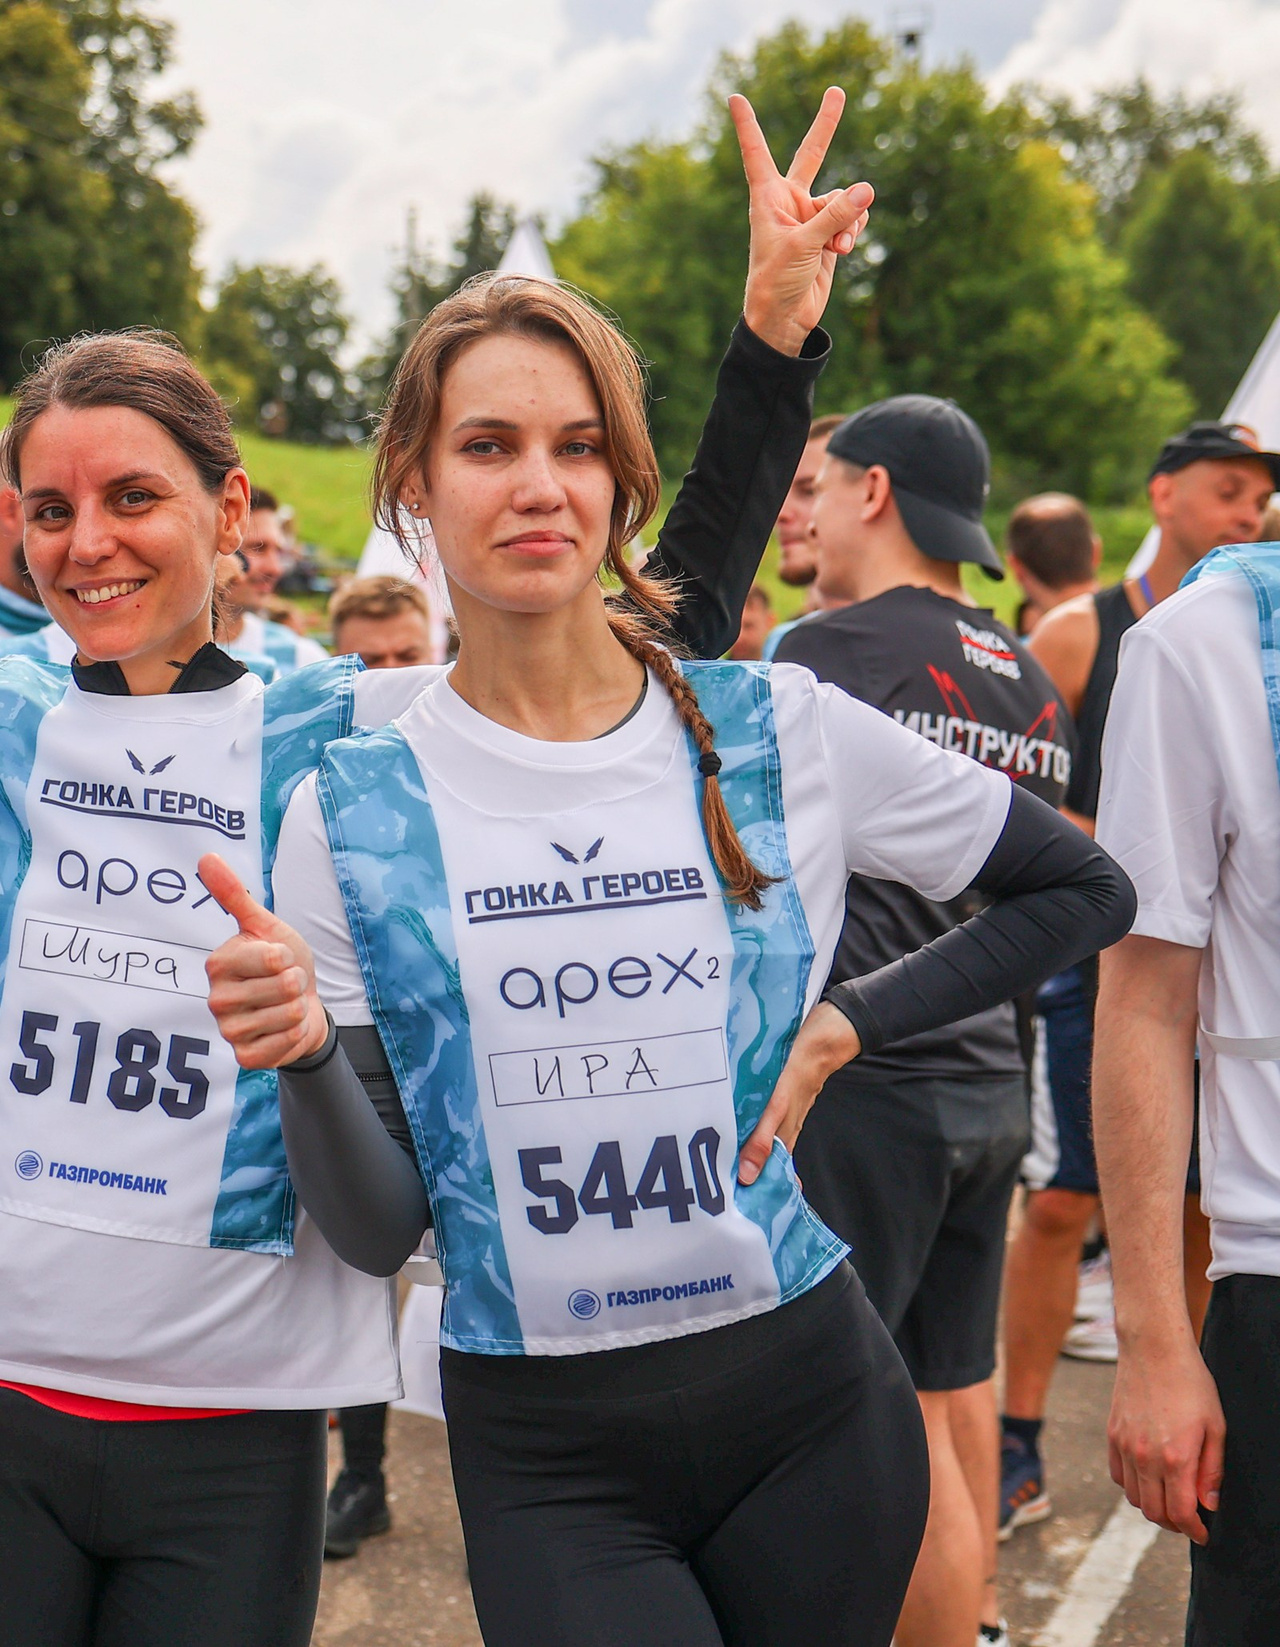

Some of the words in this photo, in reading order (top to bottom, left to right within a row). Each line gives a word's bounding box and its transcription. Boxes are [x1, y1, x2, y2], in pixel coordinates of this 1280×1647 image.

[893, 709, 1071, 786] ИНСТРУКТО
[41, 779, 135, 810] ГОНКА
[143, 788, 246, 831] ГЕРОЕВ
[465, 881, 574, 914] ГОНКА
[582, 867, 704, 900] ГЕРОЕВ
[500, 948, 704, 1018] apex
[9, 1011, 210, 1120] 5185
[533, 1047, 659, 1097] ИРА
[49, 1161, 168, 1196] ГАЗПРОМБАНК
[518, 1126, 725, 1235] 5440
[607, 1274, 734, 1308] ГАЗПРОМБАНК
